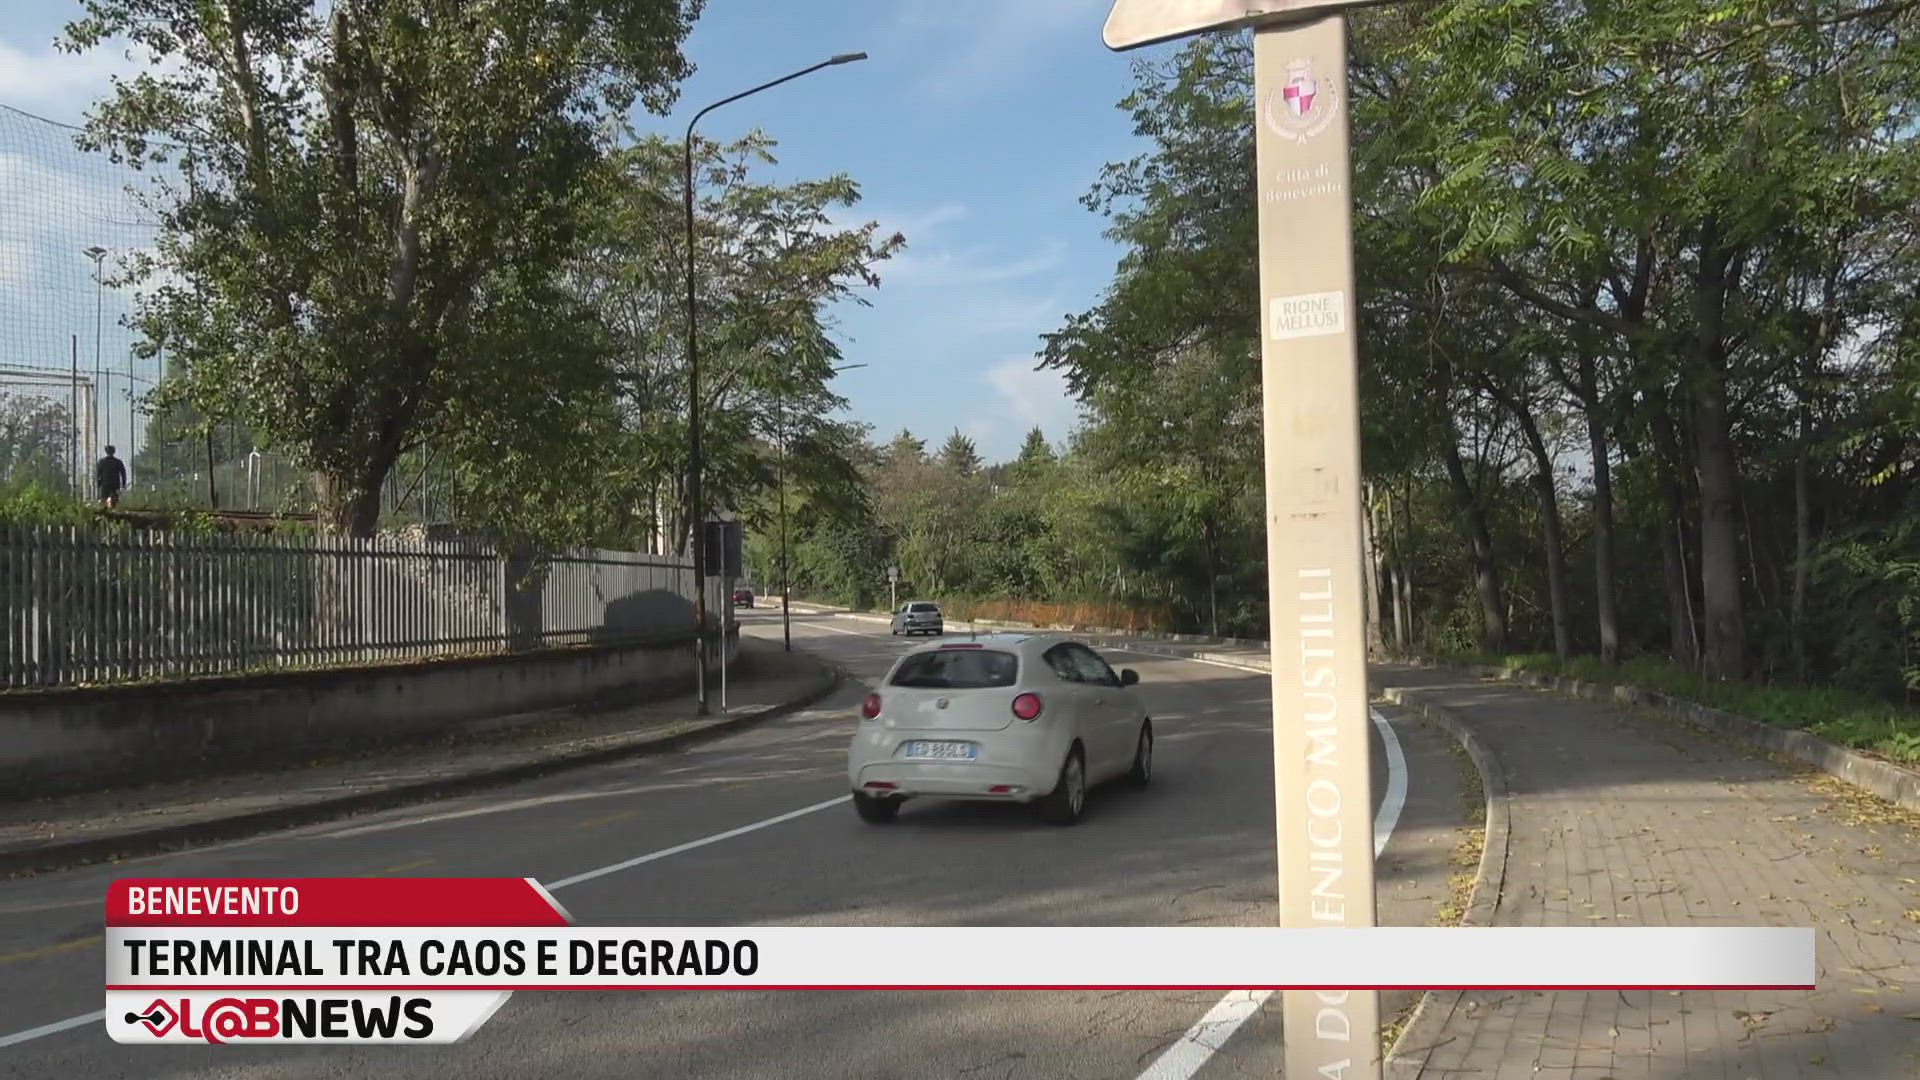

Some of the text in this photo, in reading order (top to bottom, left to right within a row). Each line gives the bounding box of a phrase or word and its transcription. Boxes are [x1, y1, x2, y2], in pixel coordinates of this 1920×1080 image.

[1314, 160, 1329, 177] di
[1265, 182, 1342, 201] Benevento
[1282, 297, 1331, 315] RIONE
[1275, 310, 1339, 333] MELLUSI
[1297, 566, 1340, 768] MUSTILLI
